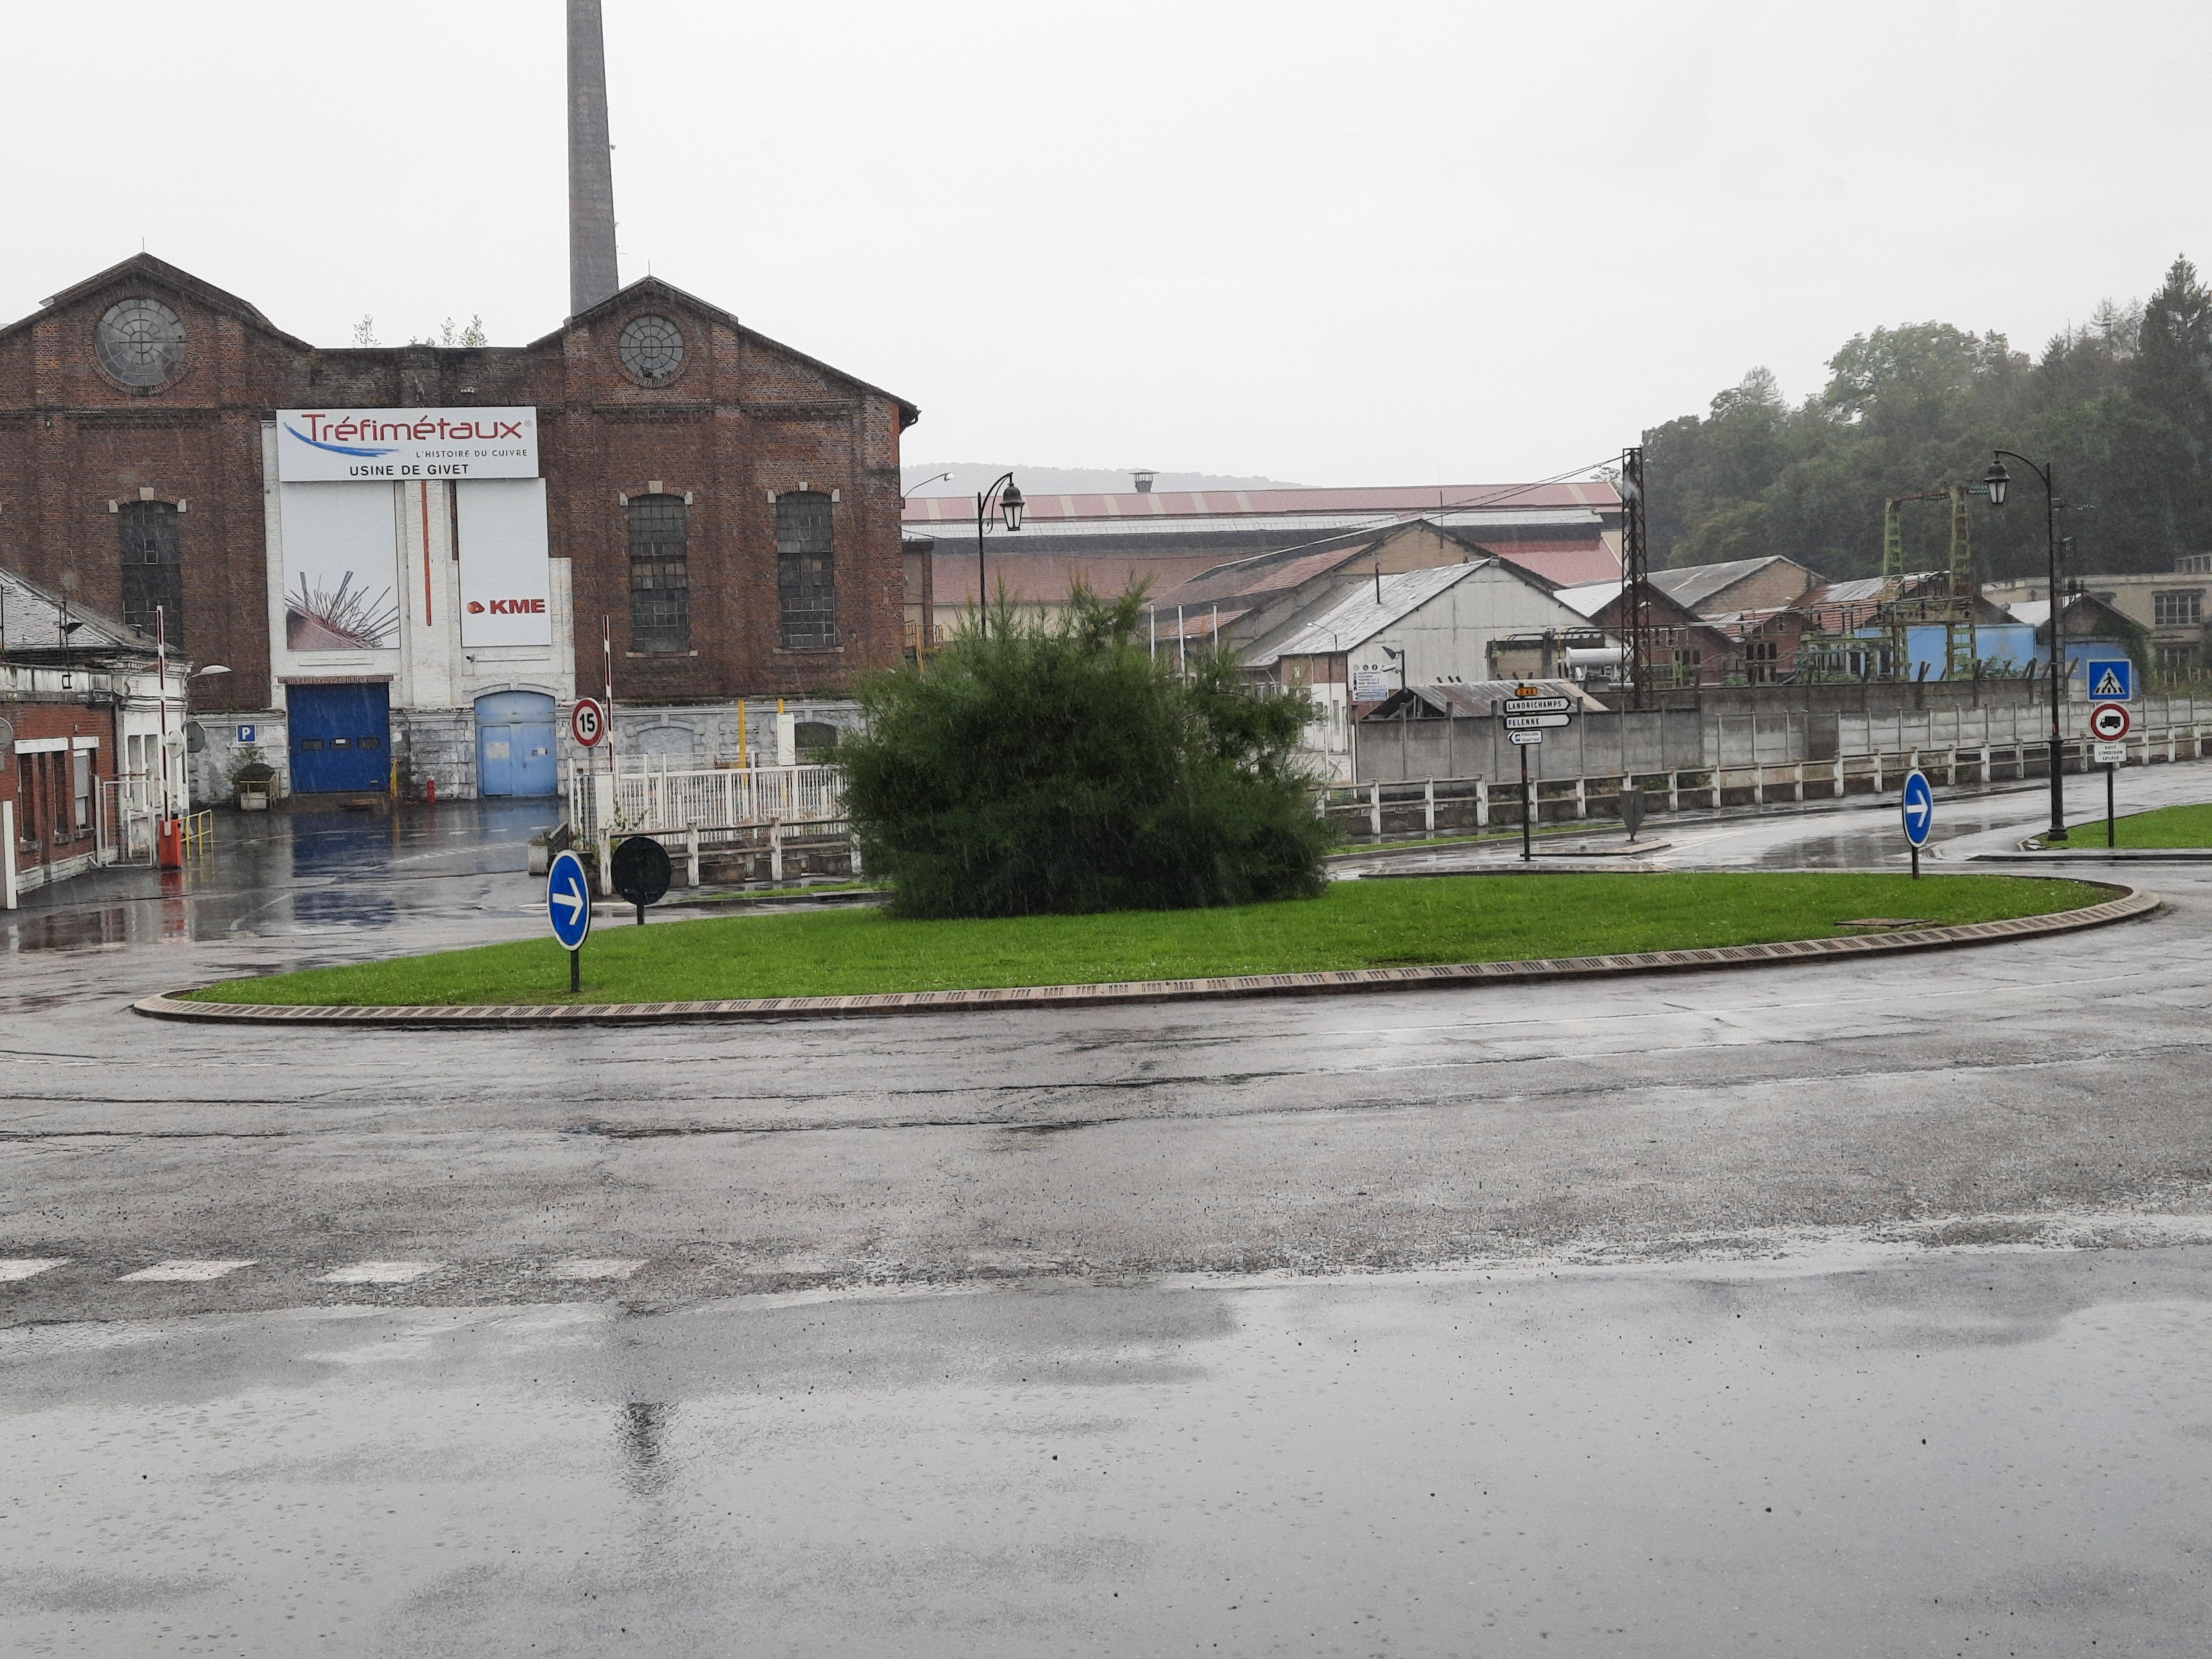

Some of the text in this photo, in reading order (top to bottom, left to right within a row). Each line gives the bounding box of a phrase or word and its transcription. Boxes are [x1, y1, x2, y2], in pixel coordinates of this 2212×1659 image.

[301, 414, 522, 442] Tréfimétaux
[350, 464, 469, 476] USINE DE GIVET
[490, 599, 545, 614] KME
[1508, 700, 1562, 710] LANDRICHAMPS
[579, 713, 596, 732] 15
[242, 727, 251, 740] P
